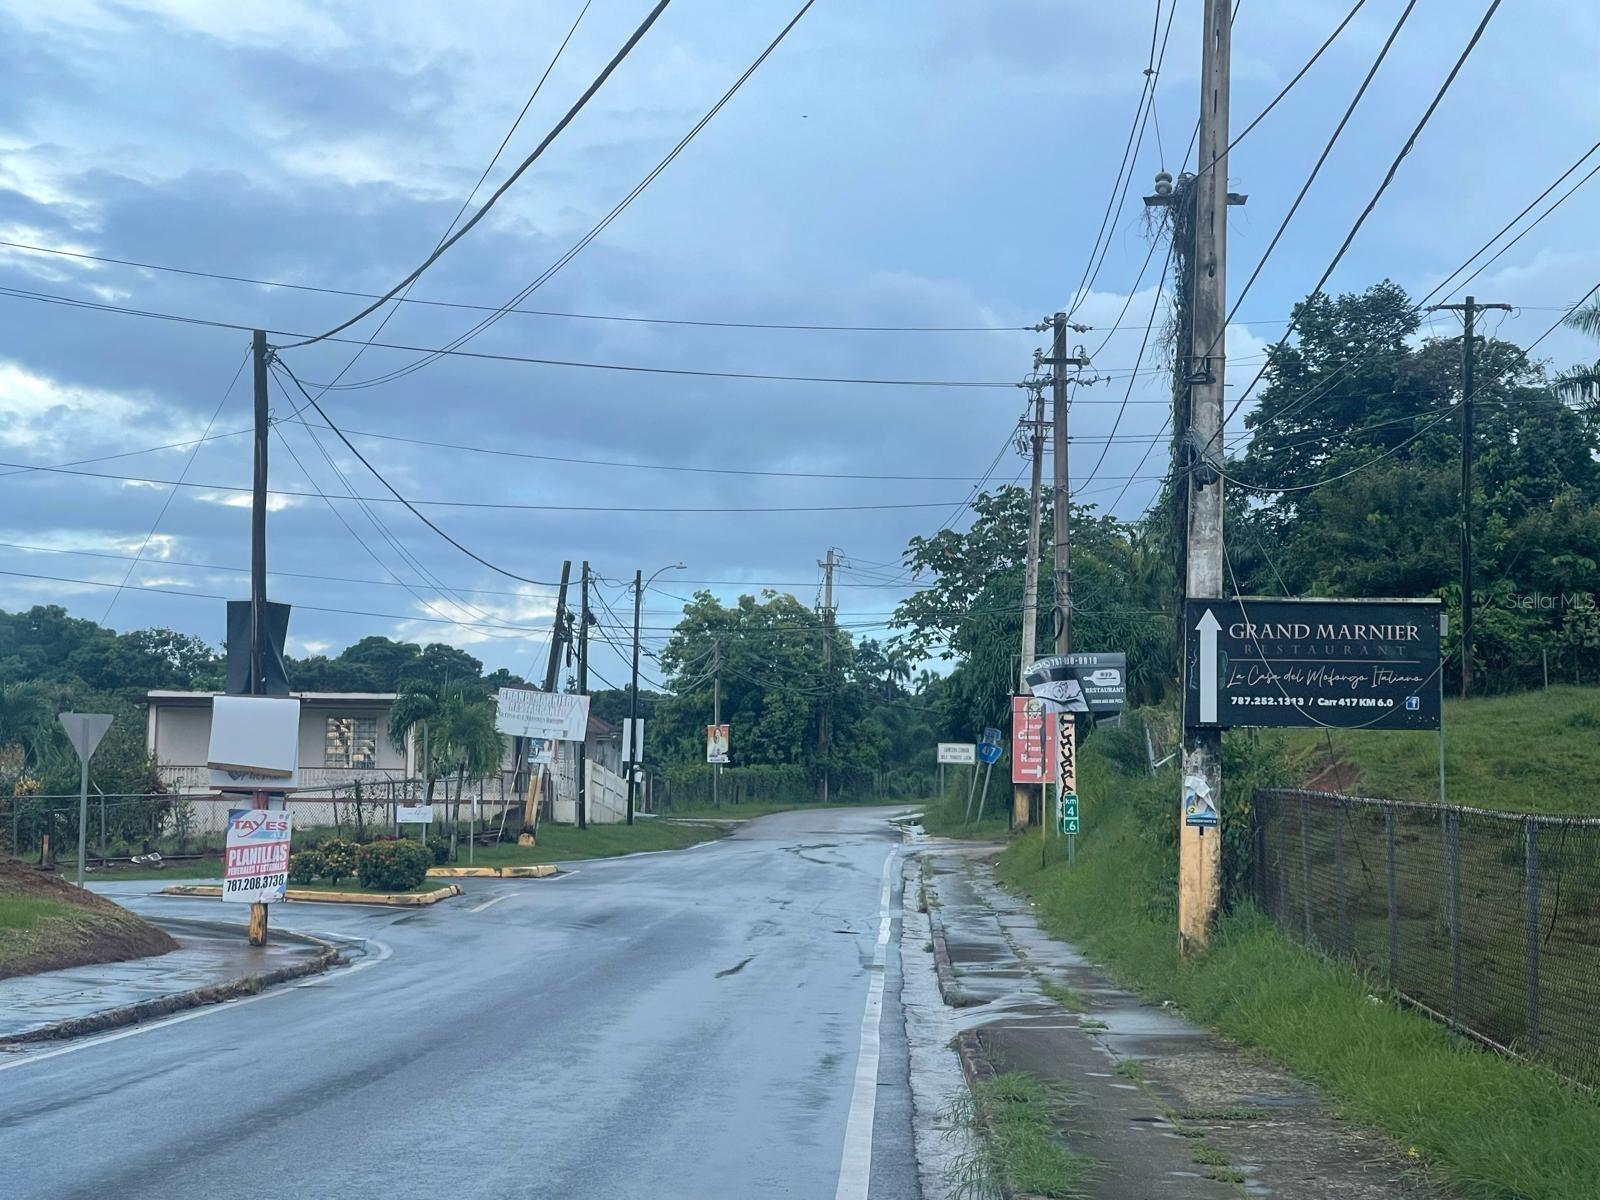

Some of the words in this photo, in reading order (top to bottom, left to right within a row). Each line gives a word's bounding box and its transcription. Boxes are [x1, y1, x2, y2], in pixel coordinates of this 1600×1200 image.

[1229, 623, 1310, 640] GRAND
[1316, 624, 1420, 641] MARNIER
[1244, 645, 1407, 656] RESTAURANT
[1227, 664, 1245, 688] La
[1247, 664, 1281, 686] Casa
[1283, 666, 1304, 683] del
[1306, 665, 1368, 689] Mofongo
[1371, 665, 1423, 688] Italiano
[501, 690, 530, 702] GRAND
[1231, 697, 1304, 706] 787.252.1313
[1318, 697, 1339, 706] Carr
[1339, 698, 1358, 707] 417
[1359, 698, 1376, 707] KM
[1377, 698, 1394, 708] 6.0
[1067, 806, 1074, 816] 4
[228, 844, 288, 867] PLANILLAS
[227, 874, 284, 893] 787.208.3738
